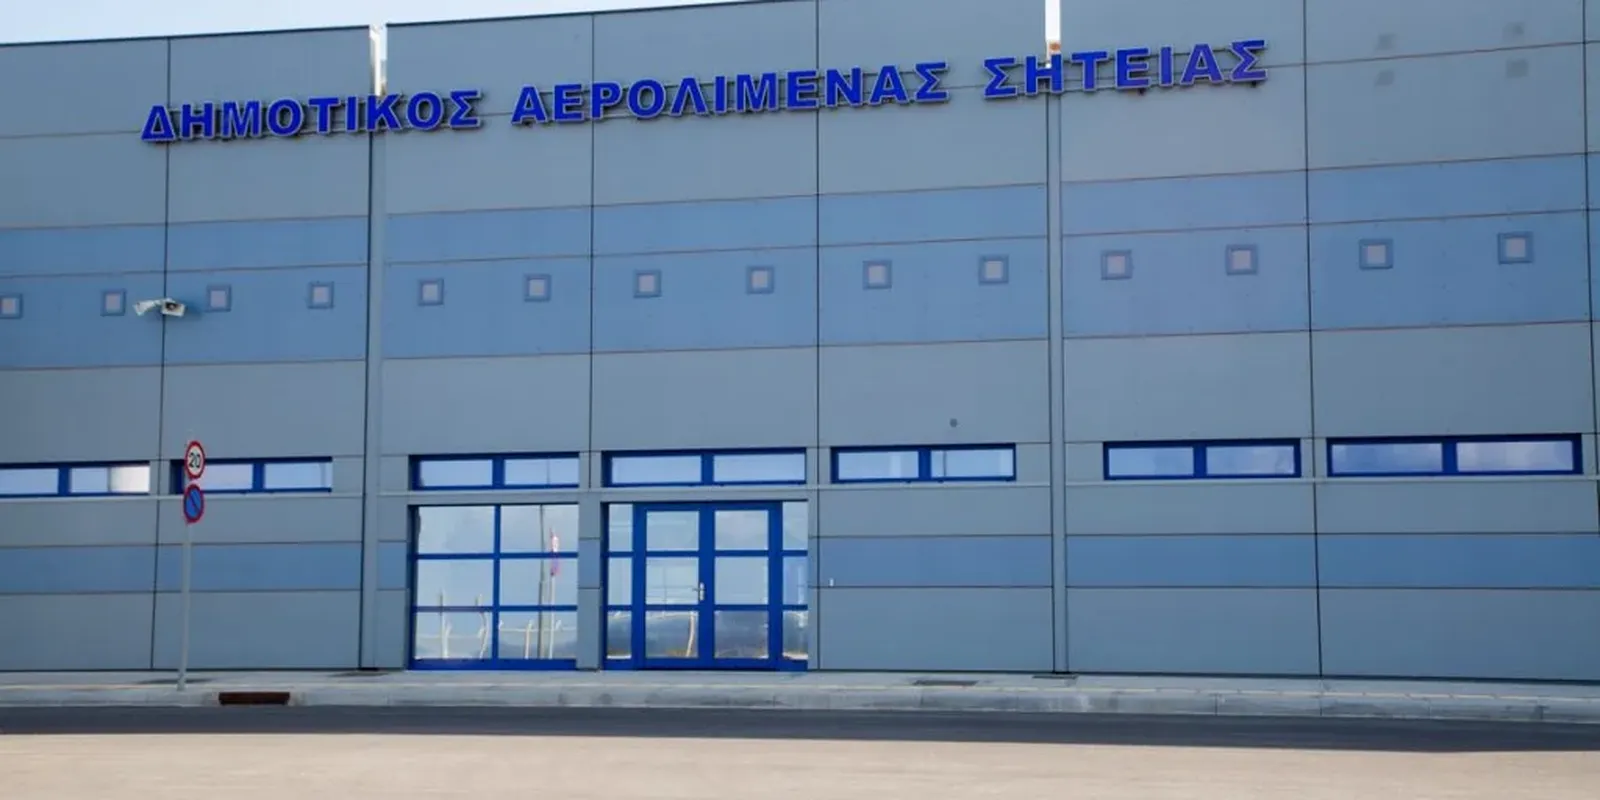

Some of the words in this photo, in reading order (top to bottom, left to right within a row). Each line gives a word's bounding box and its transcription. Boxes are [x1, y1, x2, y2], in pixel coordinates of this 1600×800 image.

[140, 88, 481, 142] ΔΗΜΟΤΙΚΟΣ
[511, 60, 949, 125] ΑΕΡΟΛΙΜΕΝΑΣ
[982, 38, 1267, 99] ΣΗΤΕΙΑΣ
[188, 452, 201, 469] 20
